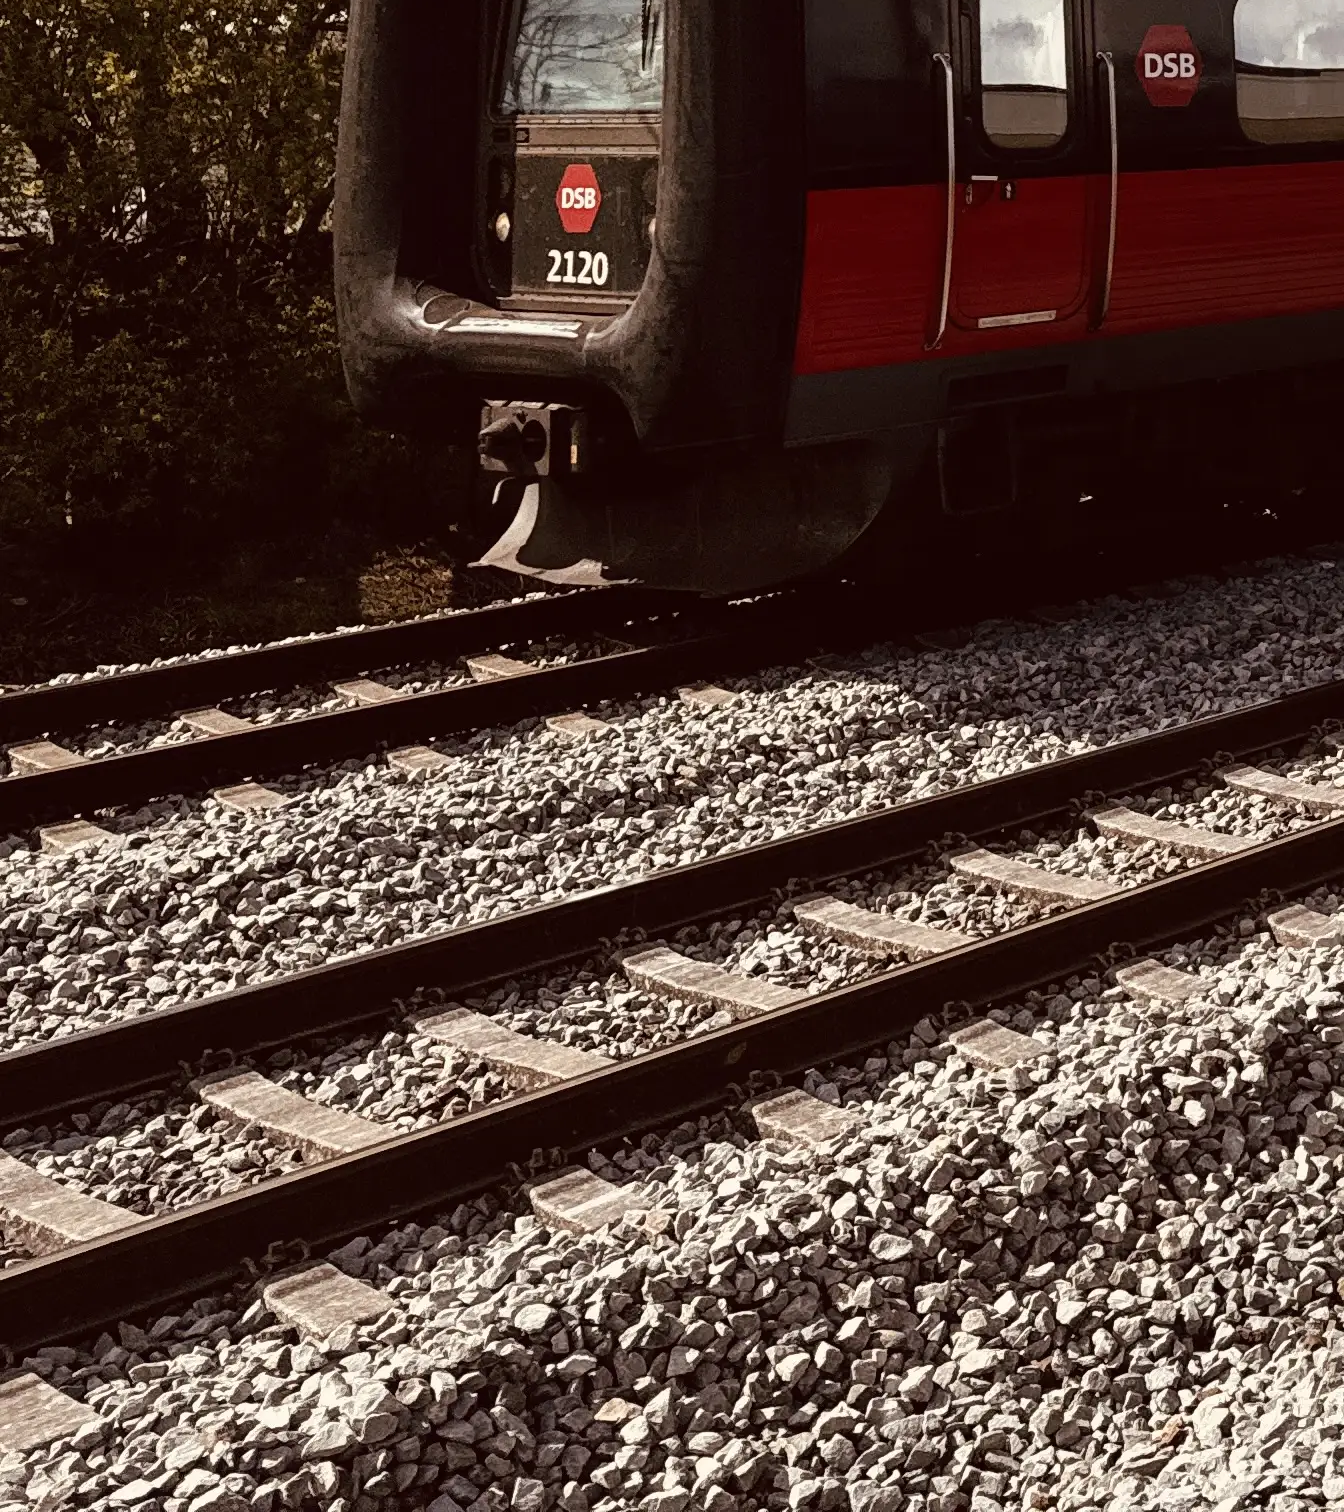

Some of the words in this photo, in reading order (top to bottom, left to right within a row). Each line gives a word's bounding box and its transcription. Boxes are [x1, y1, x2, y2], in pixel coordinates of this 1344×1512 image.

[1144, 52, 1196, 78] DSB
[561, 187, 596, 209] DSB
[546, 249, 609, 286] 2120
